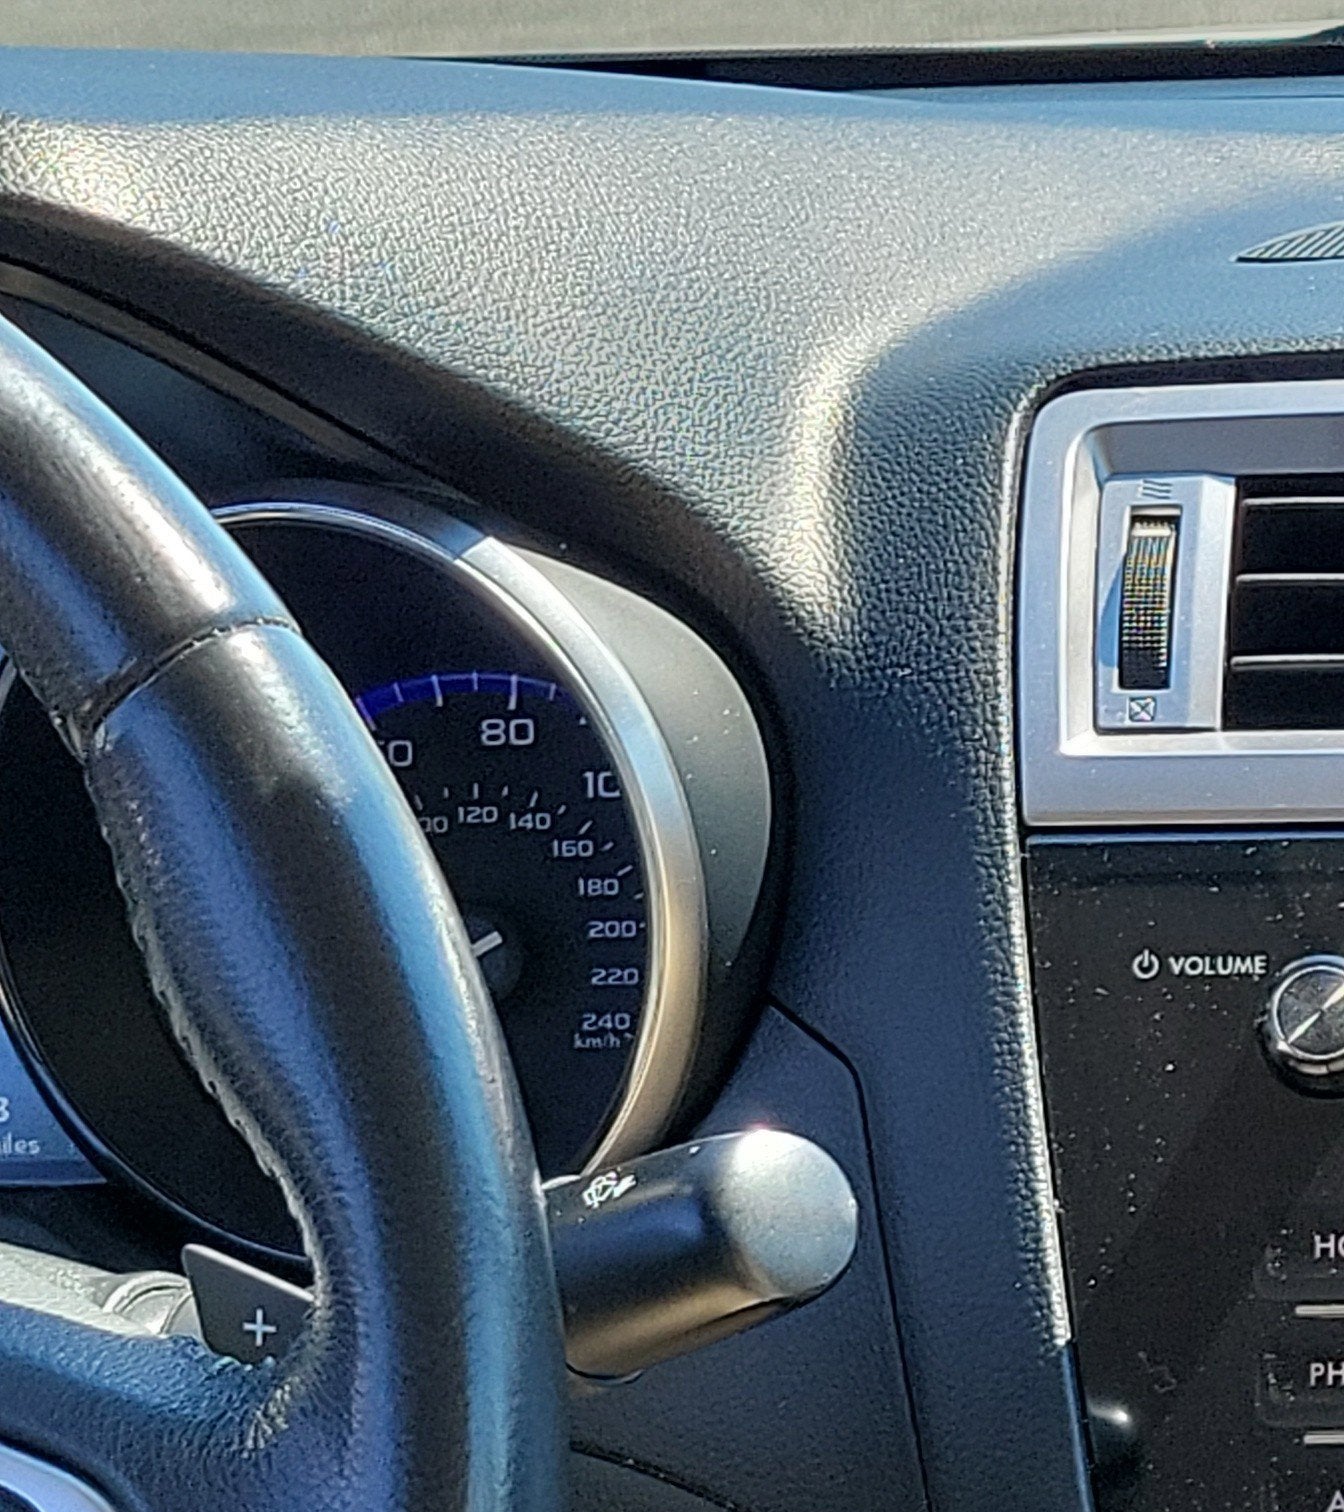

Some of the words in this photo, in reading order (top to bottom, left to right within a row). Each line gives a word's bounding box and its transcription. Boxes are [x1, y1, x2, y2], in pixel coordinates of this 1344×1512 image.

[481, 719, 534, 745] 80
[377, 740, 413, 767] 0
[457, 807, 498, 823] 120
[509, 813, 551, 830] 140
[552, 839, 594, 857] 160
[578, 877, 619, 896] 180
[588, 920, 636, 938] 200
[1168, 955, 1267, 976] VOLUME
[591, 968, 639, 985] 220
[582, 1013, 631, 1030] 240
[574, 1032, 620, 1048] km/h
[0, 1132, 40, 1154] iles
